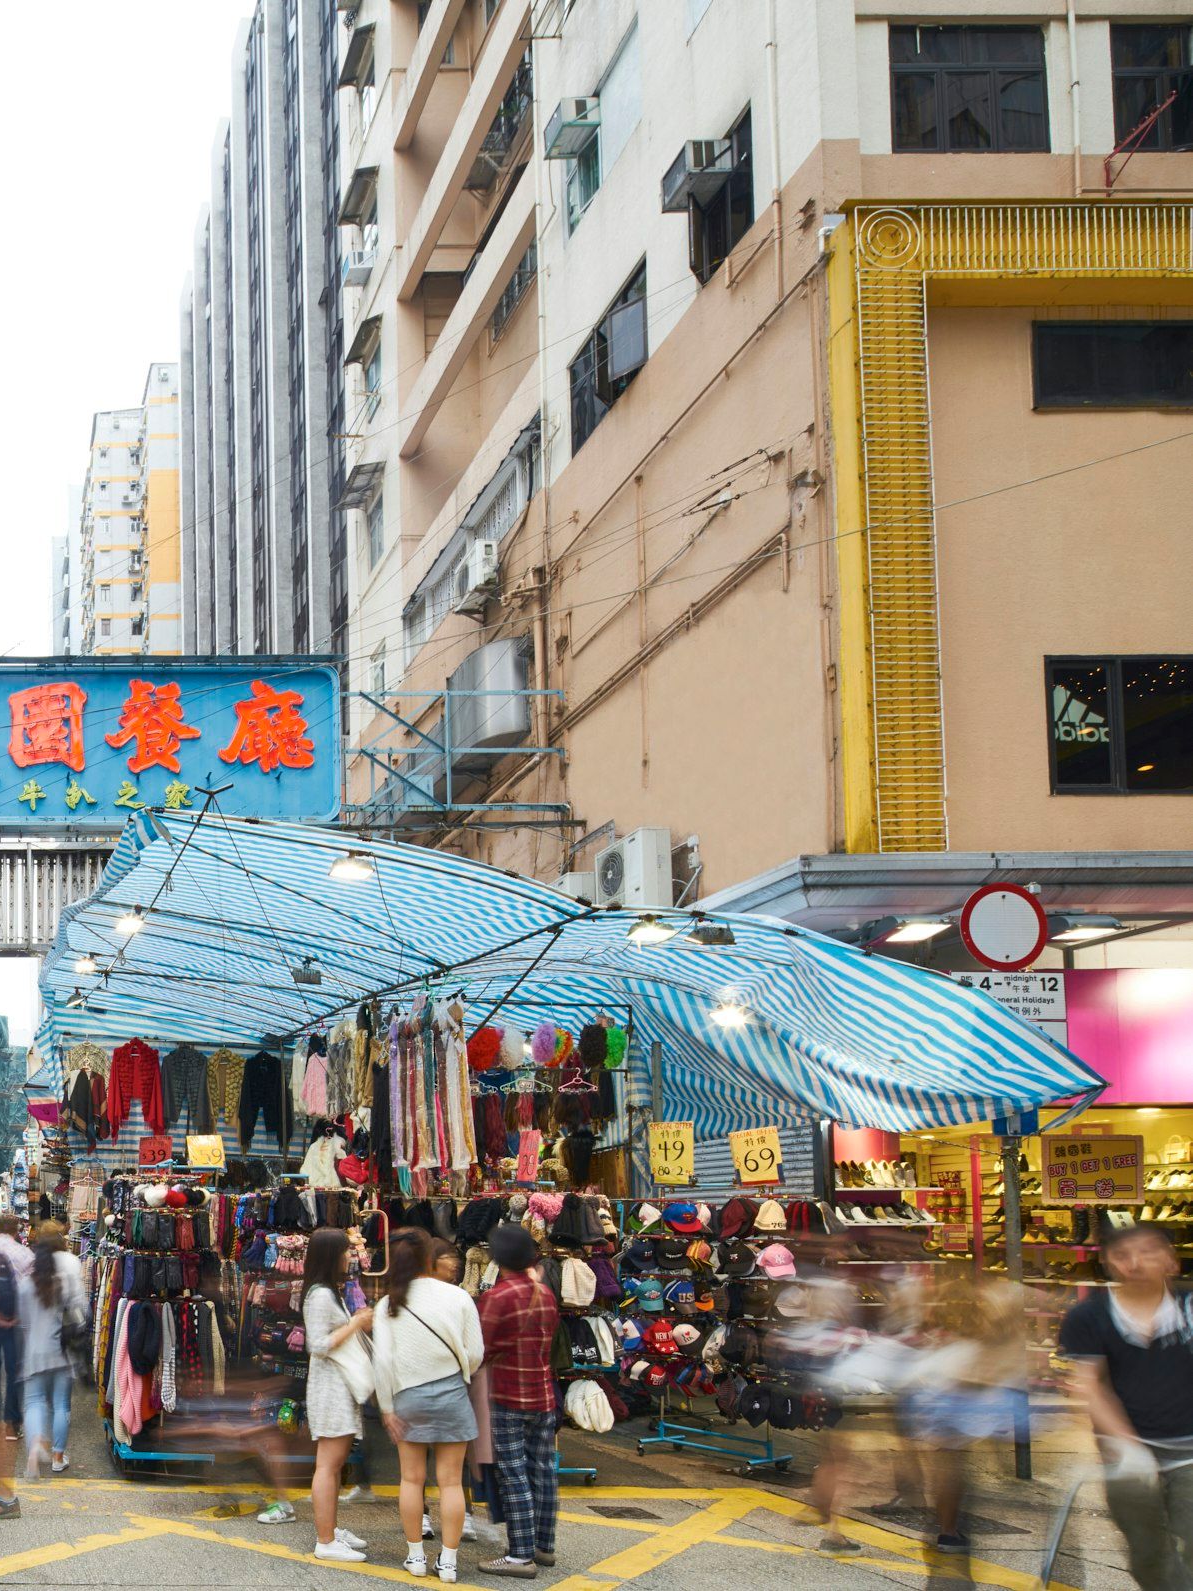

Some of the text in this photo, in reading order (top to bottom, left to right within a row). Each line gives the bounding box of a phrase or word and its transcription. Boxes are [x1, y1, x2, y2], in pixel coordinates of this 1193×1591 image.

[18, 779, 193, 811] 牛扒之家
[979, 976, 992, 991] 4
[1004, 975, 1037, 983] midnight
[1039, 977, 1059, 992] 12
[1012, 985, 1031, 993] 午夜
[1022, 996, 1055, 1004] Holidays
[1048, 1154, 1138, 1177] BUY 1 GET 1 FREE
[678, 1292, 695, 1303] US
